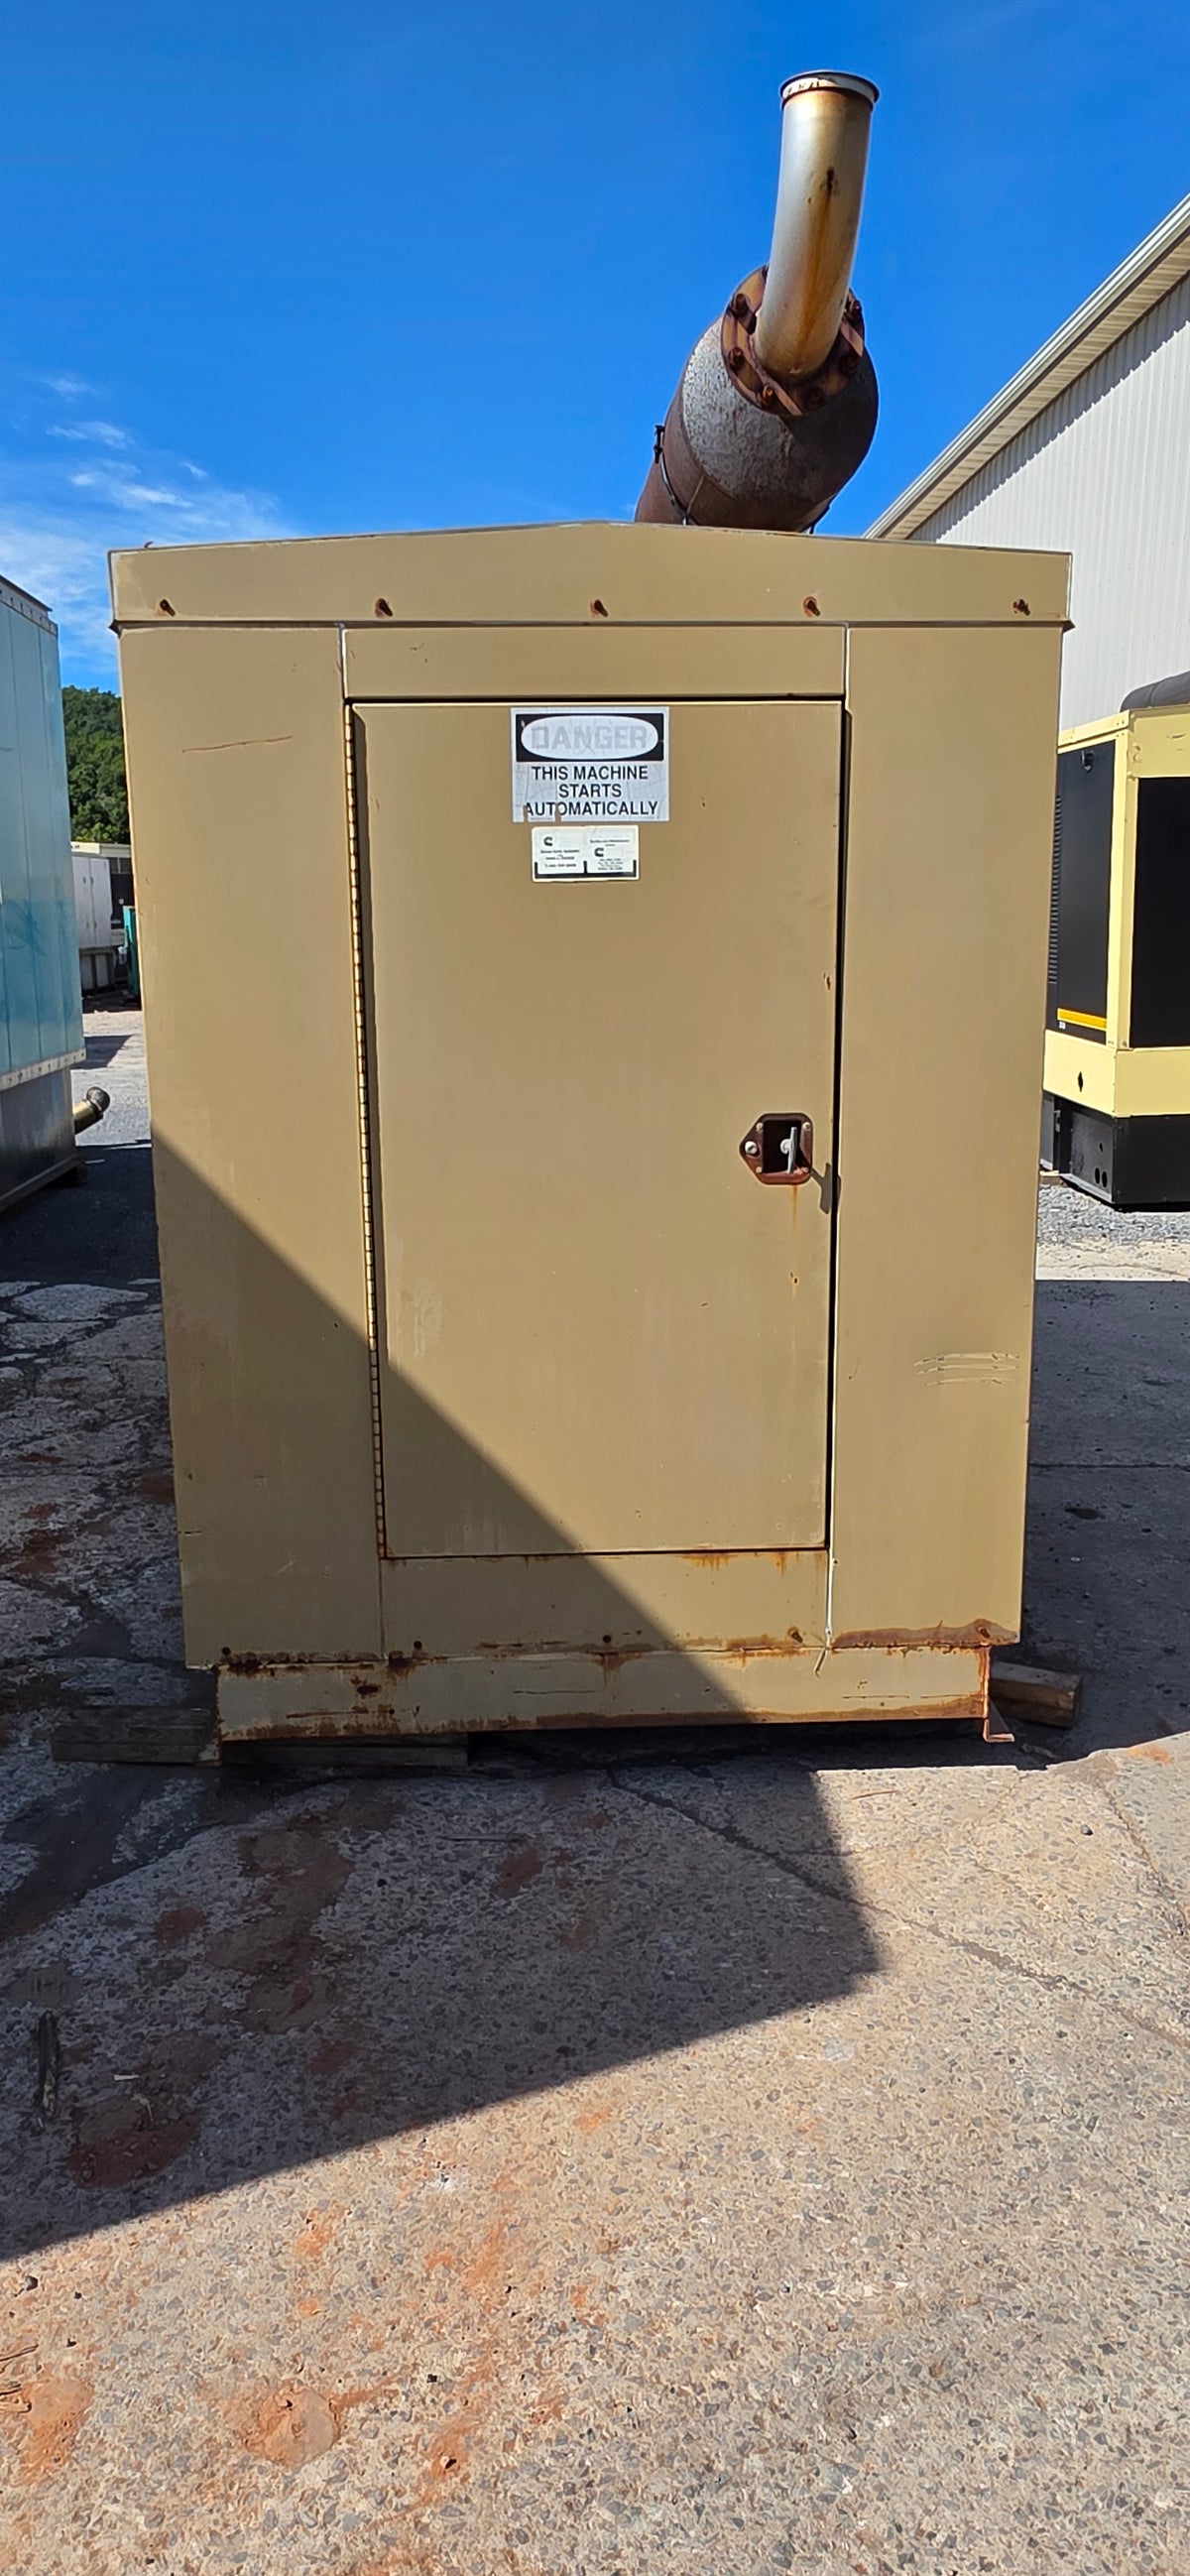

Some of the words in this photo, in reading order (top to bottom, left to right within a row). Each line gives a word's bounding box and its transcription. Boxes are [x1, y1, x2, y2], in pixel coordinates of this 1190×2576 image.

[531, 726, 648, 750] DANGER
[532, 766, 568, 781] THIS
[574, 766, 649, 781] MACHINE
[558, 784, 622, 798] STARTS
[526, 800, 658, 816] AUTOMATICALLY
